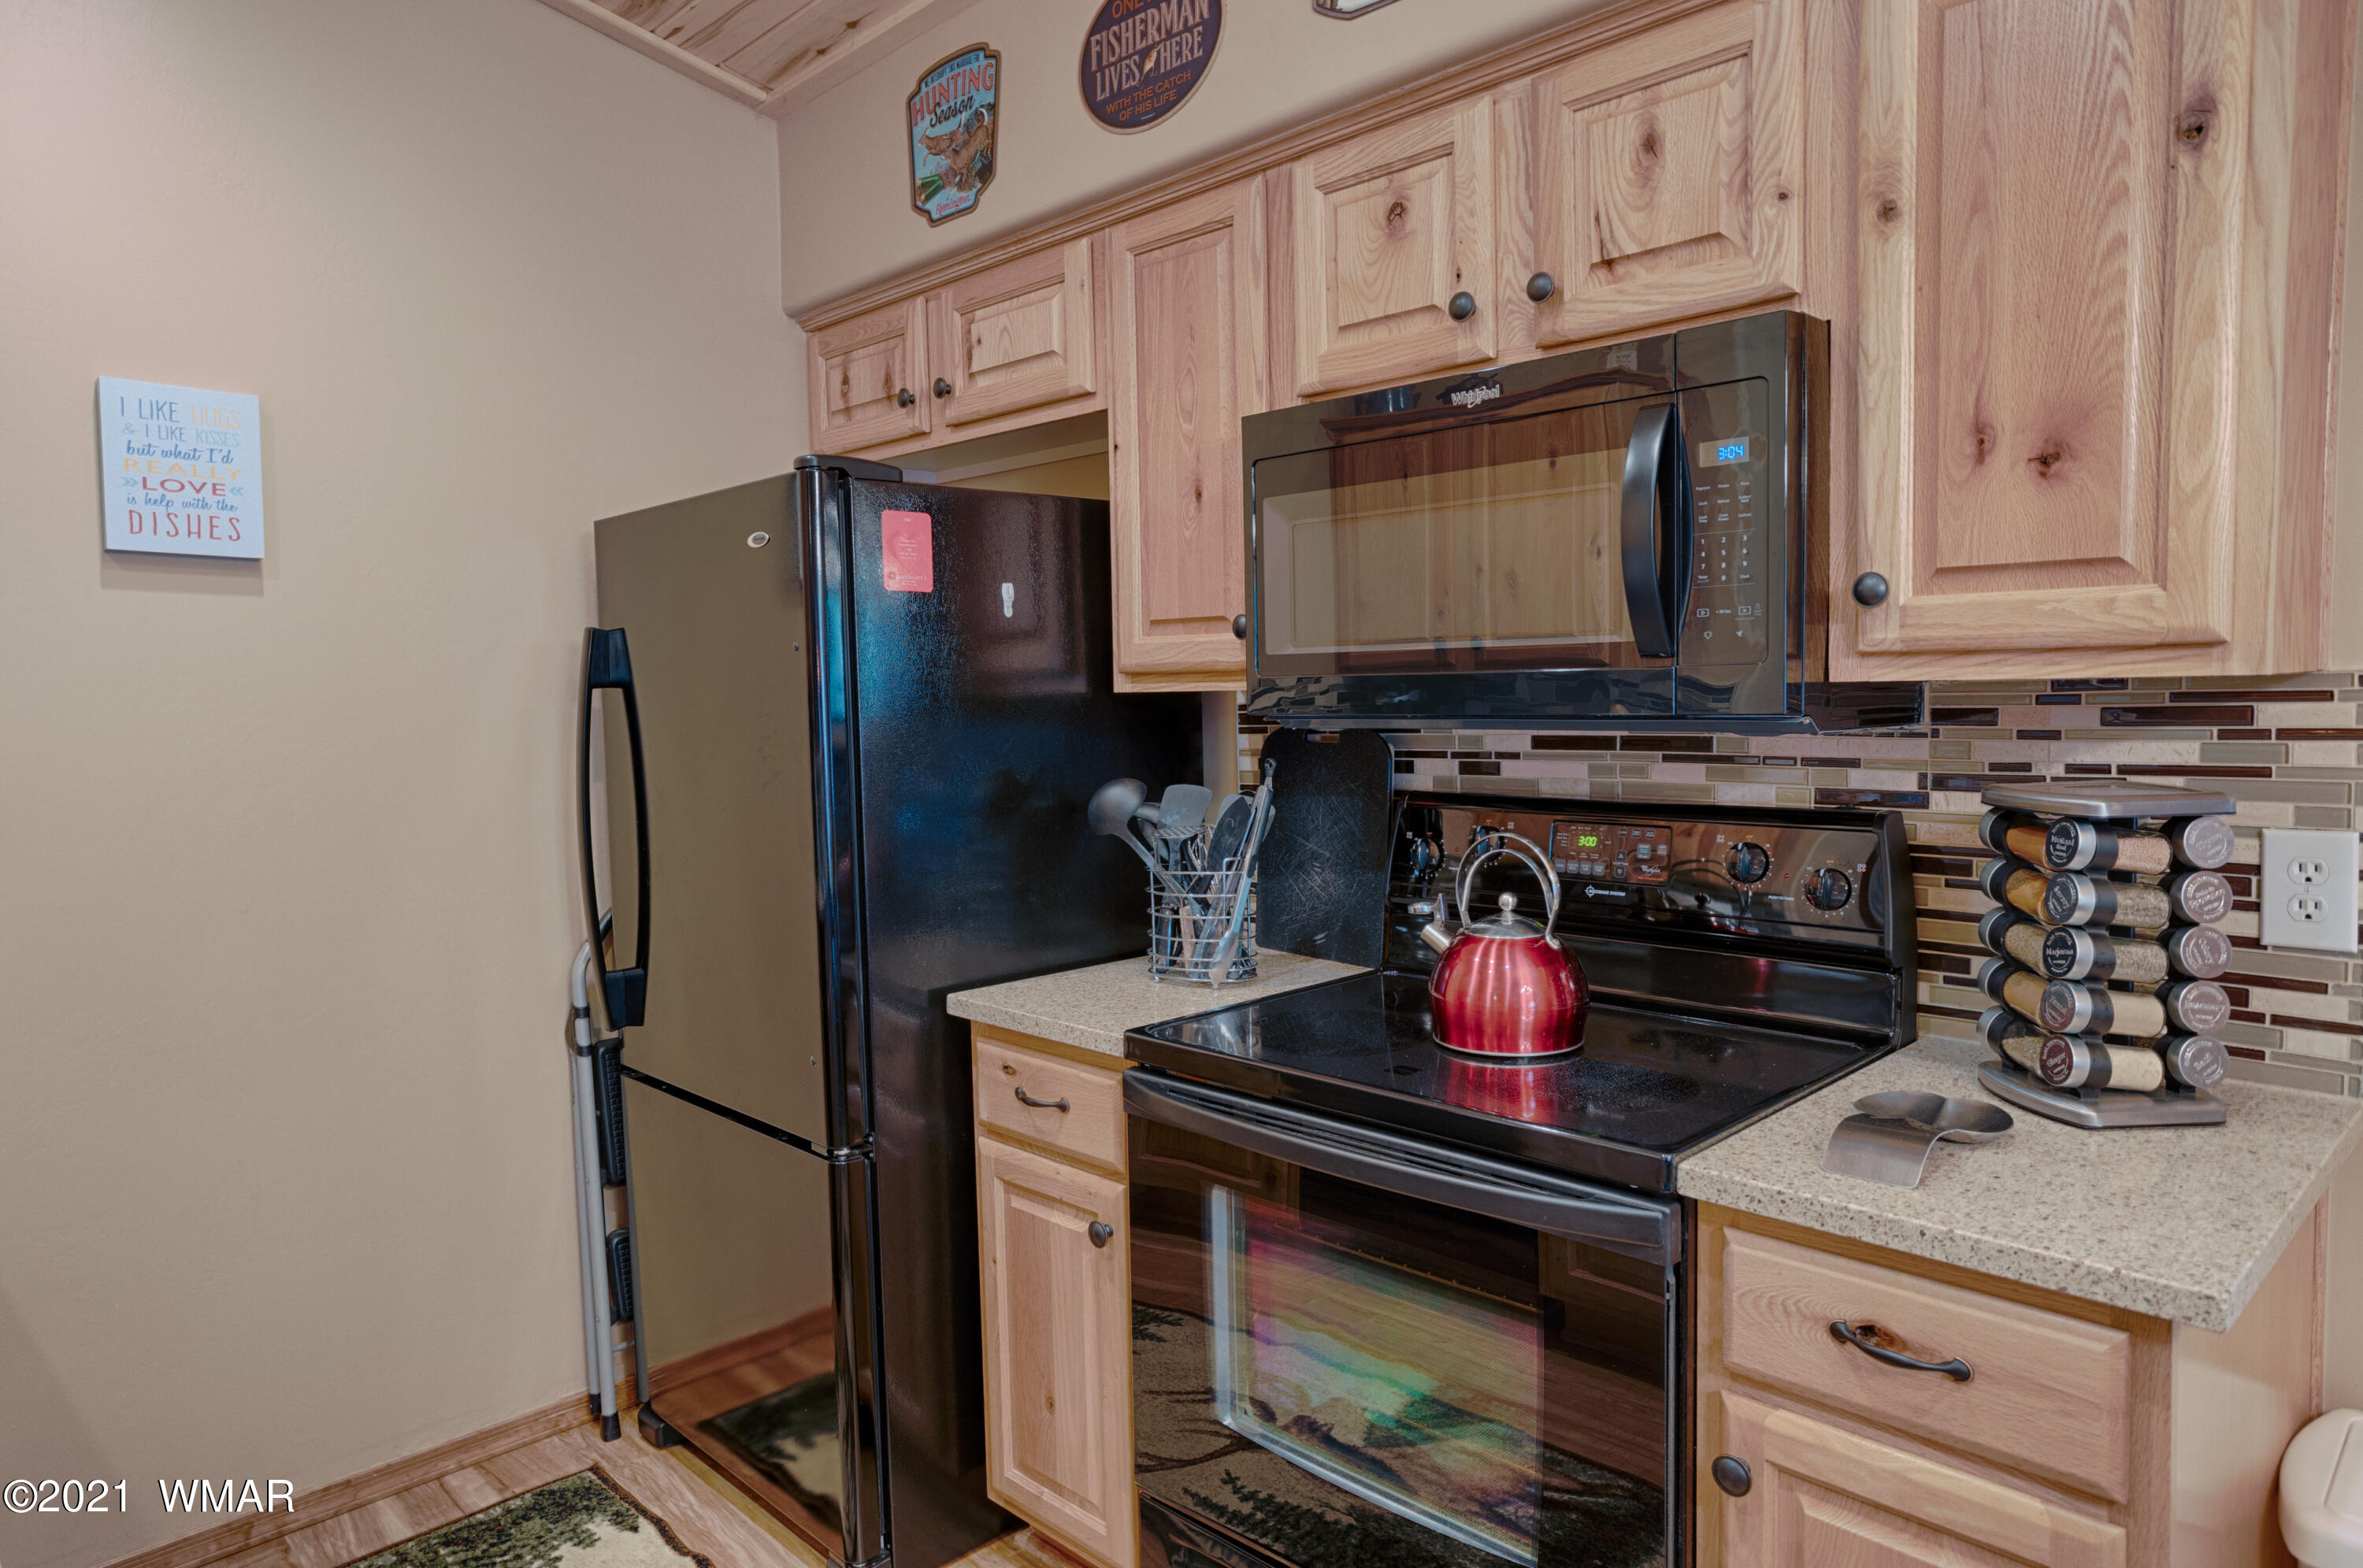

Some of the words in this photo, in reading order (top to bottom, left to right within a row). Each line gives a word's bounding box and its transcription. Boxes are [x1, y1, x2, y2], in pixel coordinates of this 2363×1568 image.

[1090, 0, 1210, 72] FISHERMAN
[1096, 54, 1141, 101] LIVES
[1159, 25, 1203, 74] HERE
[912, 61, 994, 127] HUNTING
[1106, 97, 1132, 114] WITH
[1133, 86, 1154, 102] THE
[1155, 69, 1192, 93] CATCH
[930, 94, 974, 128] Season
[1119, 108, 1133, 122] OF
[1134, 99, 1152, 115] HIS
[1154, 89, 1177, 108] LIFE
[935, 195, 971, 217] Remington
[1451, 384, 1501, 408] Whirlpool
[120, 396, 125, 417] I
[139, 398, 180, 423] LIKE
[191, 403, 242, 430] HUGS
[121, 422, 139, 435] &
[145, 424, 150, 438] I
[158, 425, 187, 442] LIKE
[195, 428, 239, 447] KISSES
[126, 439, 160, 457] but
[161, 444, 205, 462] what
[206, 447, 233, 465] I'd
[1718, 445, 1744, 461] 3:04
[124, 458, 243, 481] REALLY
[142, 476, 227, 497] LOVE
[127, 493, 137, 505] is
[145, 492, 175, 512] help
[182, 497, 213, 512] with
[213, 499, 238, 513] the
[128, 510, 241, 542] DISHES
[1578, 836, 1597, 847] 3:00
